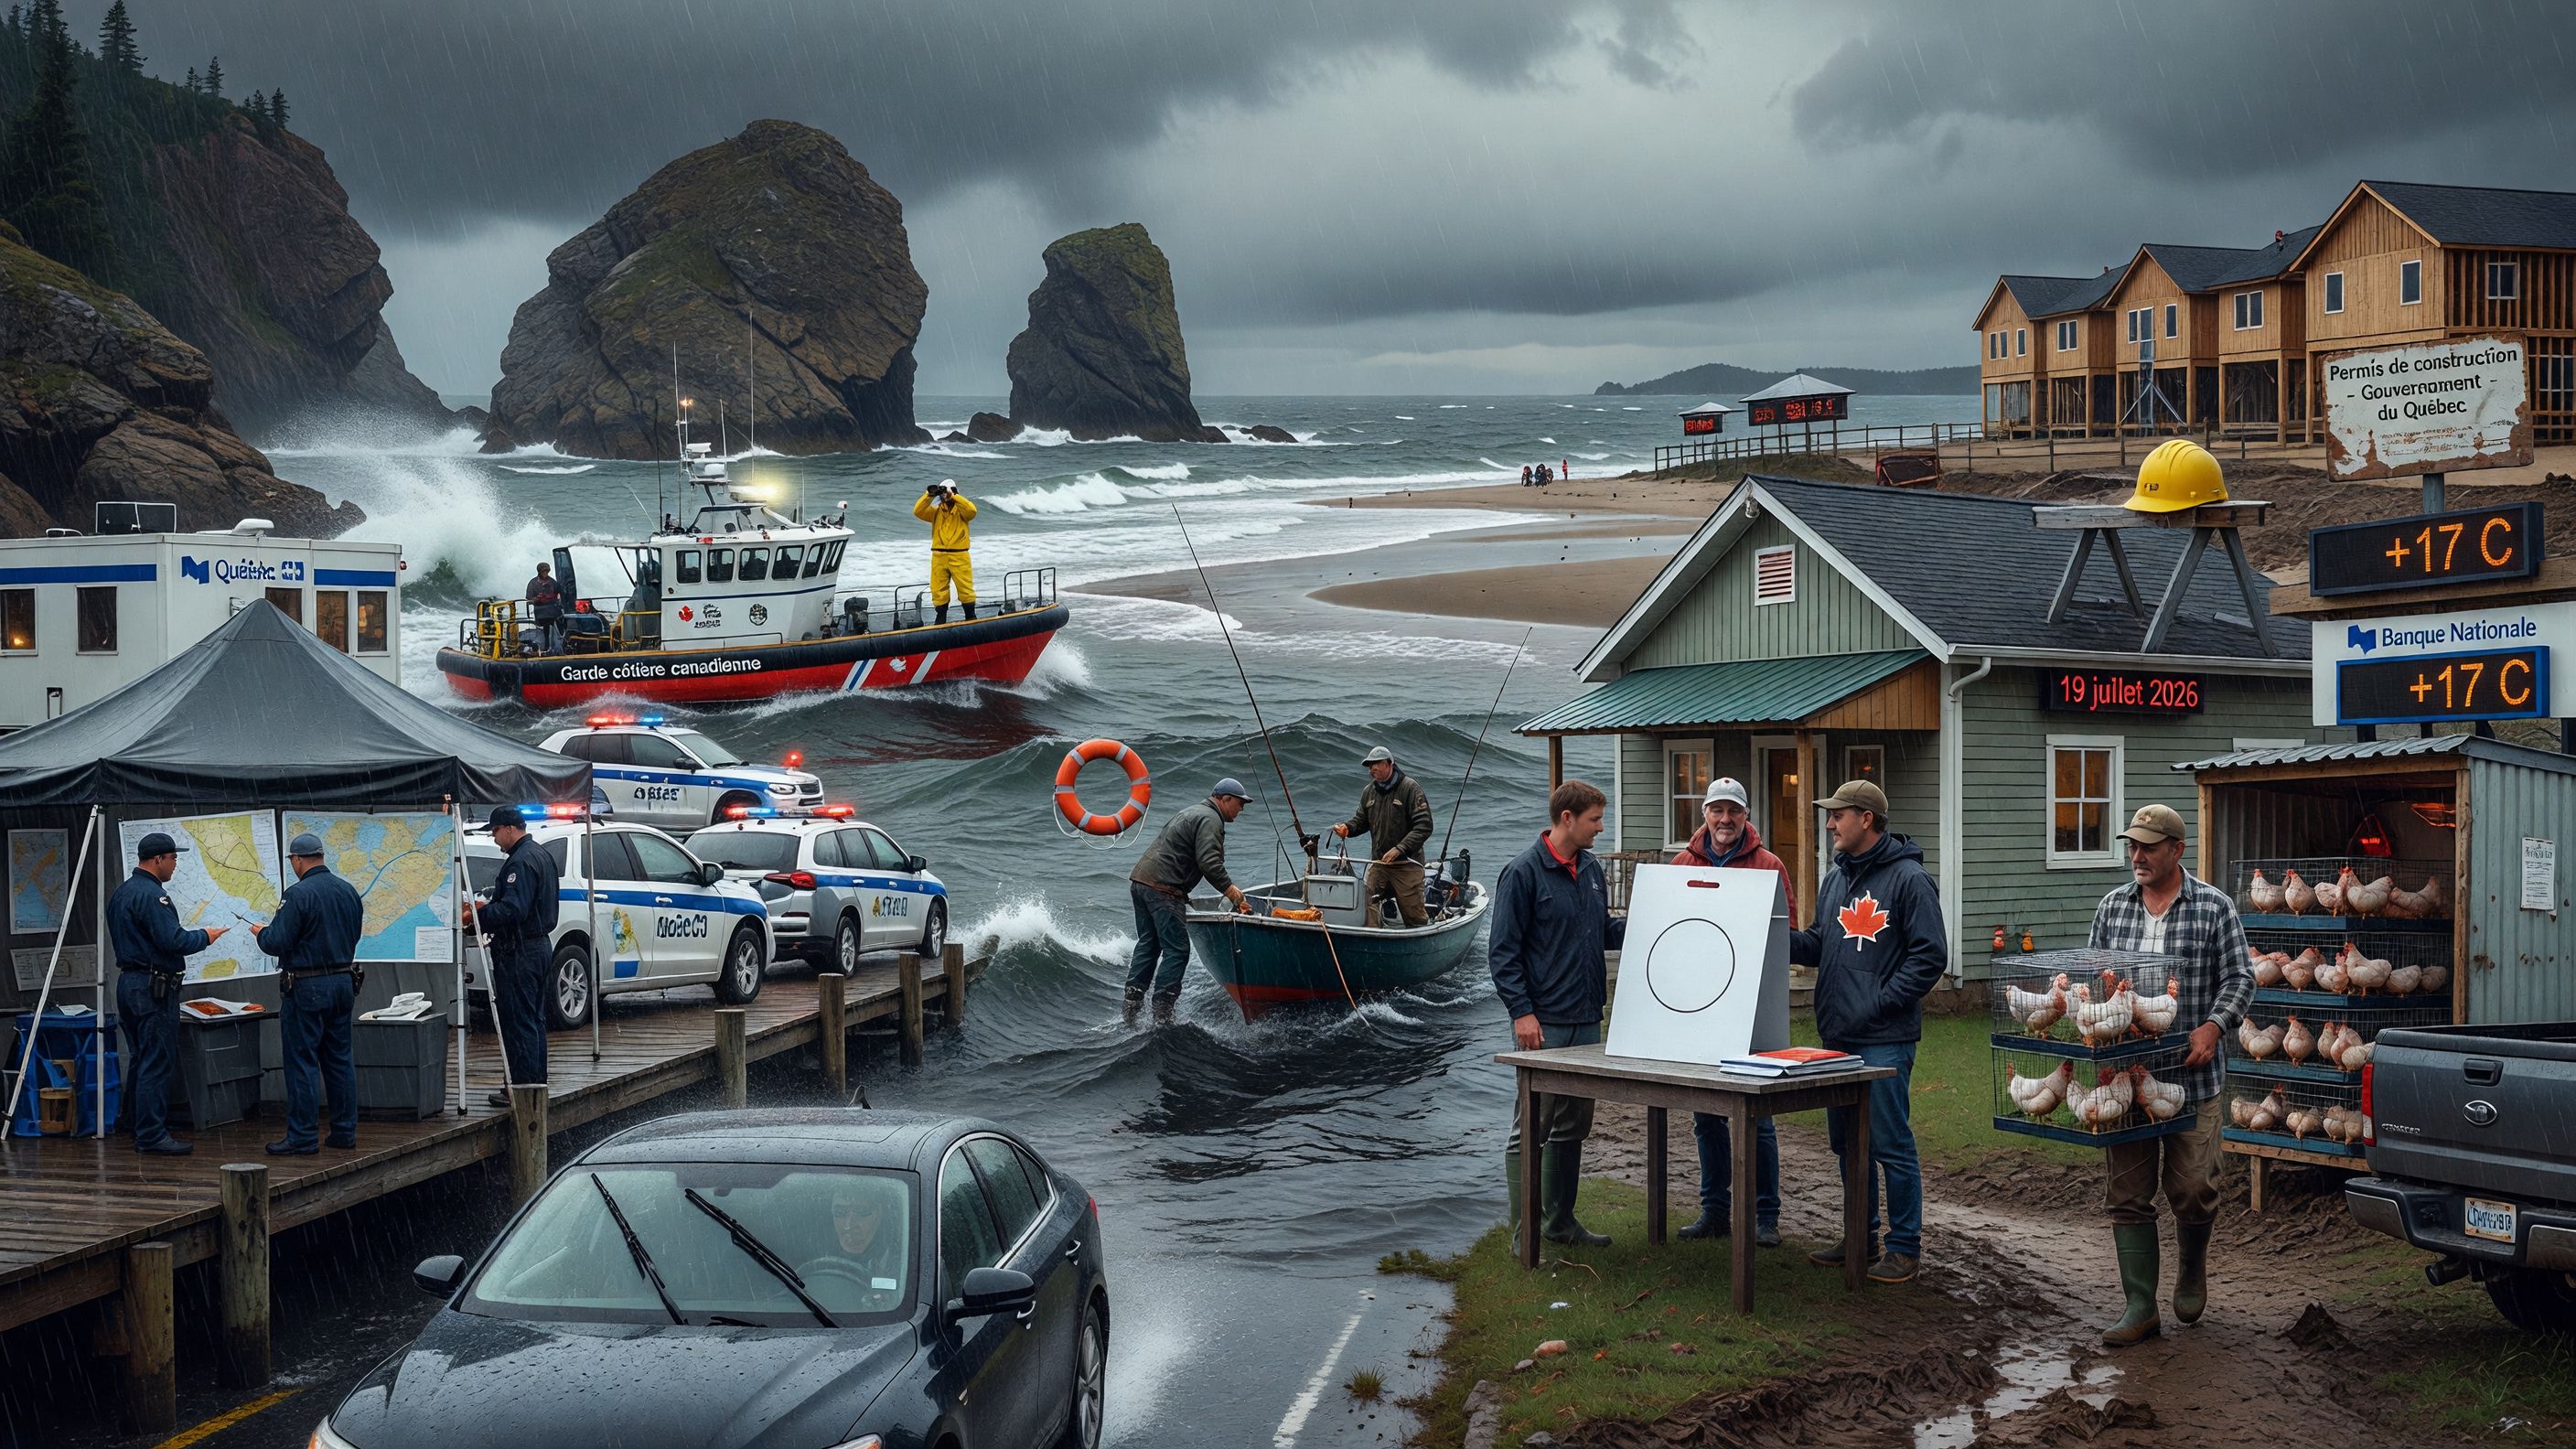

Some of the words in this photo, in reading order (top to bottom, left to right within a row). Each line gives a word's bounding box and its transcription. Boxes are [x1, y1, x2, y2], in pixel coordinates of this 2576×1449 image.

[2330, 358, 2385, 381] Permis
[2388, 357, 2410, 375] de
[2414, 347, 2517, 372] construction
[2378, 403, 2398, 421] du
[2403, 398, 2468, 421] Québec
[2386, 522, 2464, 572] +17
[2480, 517, 2513, 567] C
[2382, 628, 2445, 649] Banque
[2451, 616, 2537, 642] Nationale
[561, 665, 608, 681] Garde
[612, 662, 666, 680] côtière
[671, 657, 762, 675] canadienne
[2410, 662, 2485, 708] +17
[2499, 659, 2531, 705] C
[2060, 674, 2086, 703] 19
[2149, 679, 2199, 707] 2026
